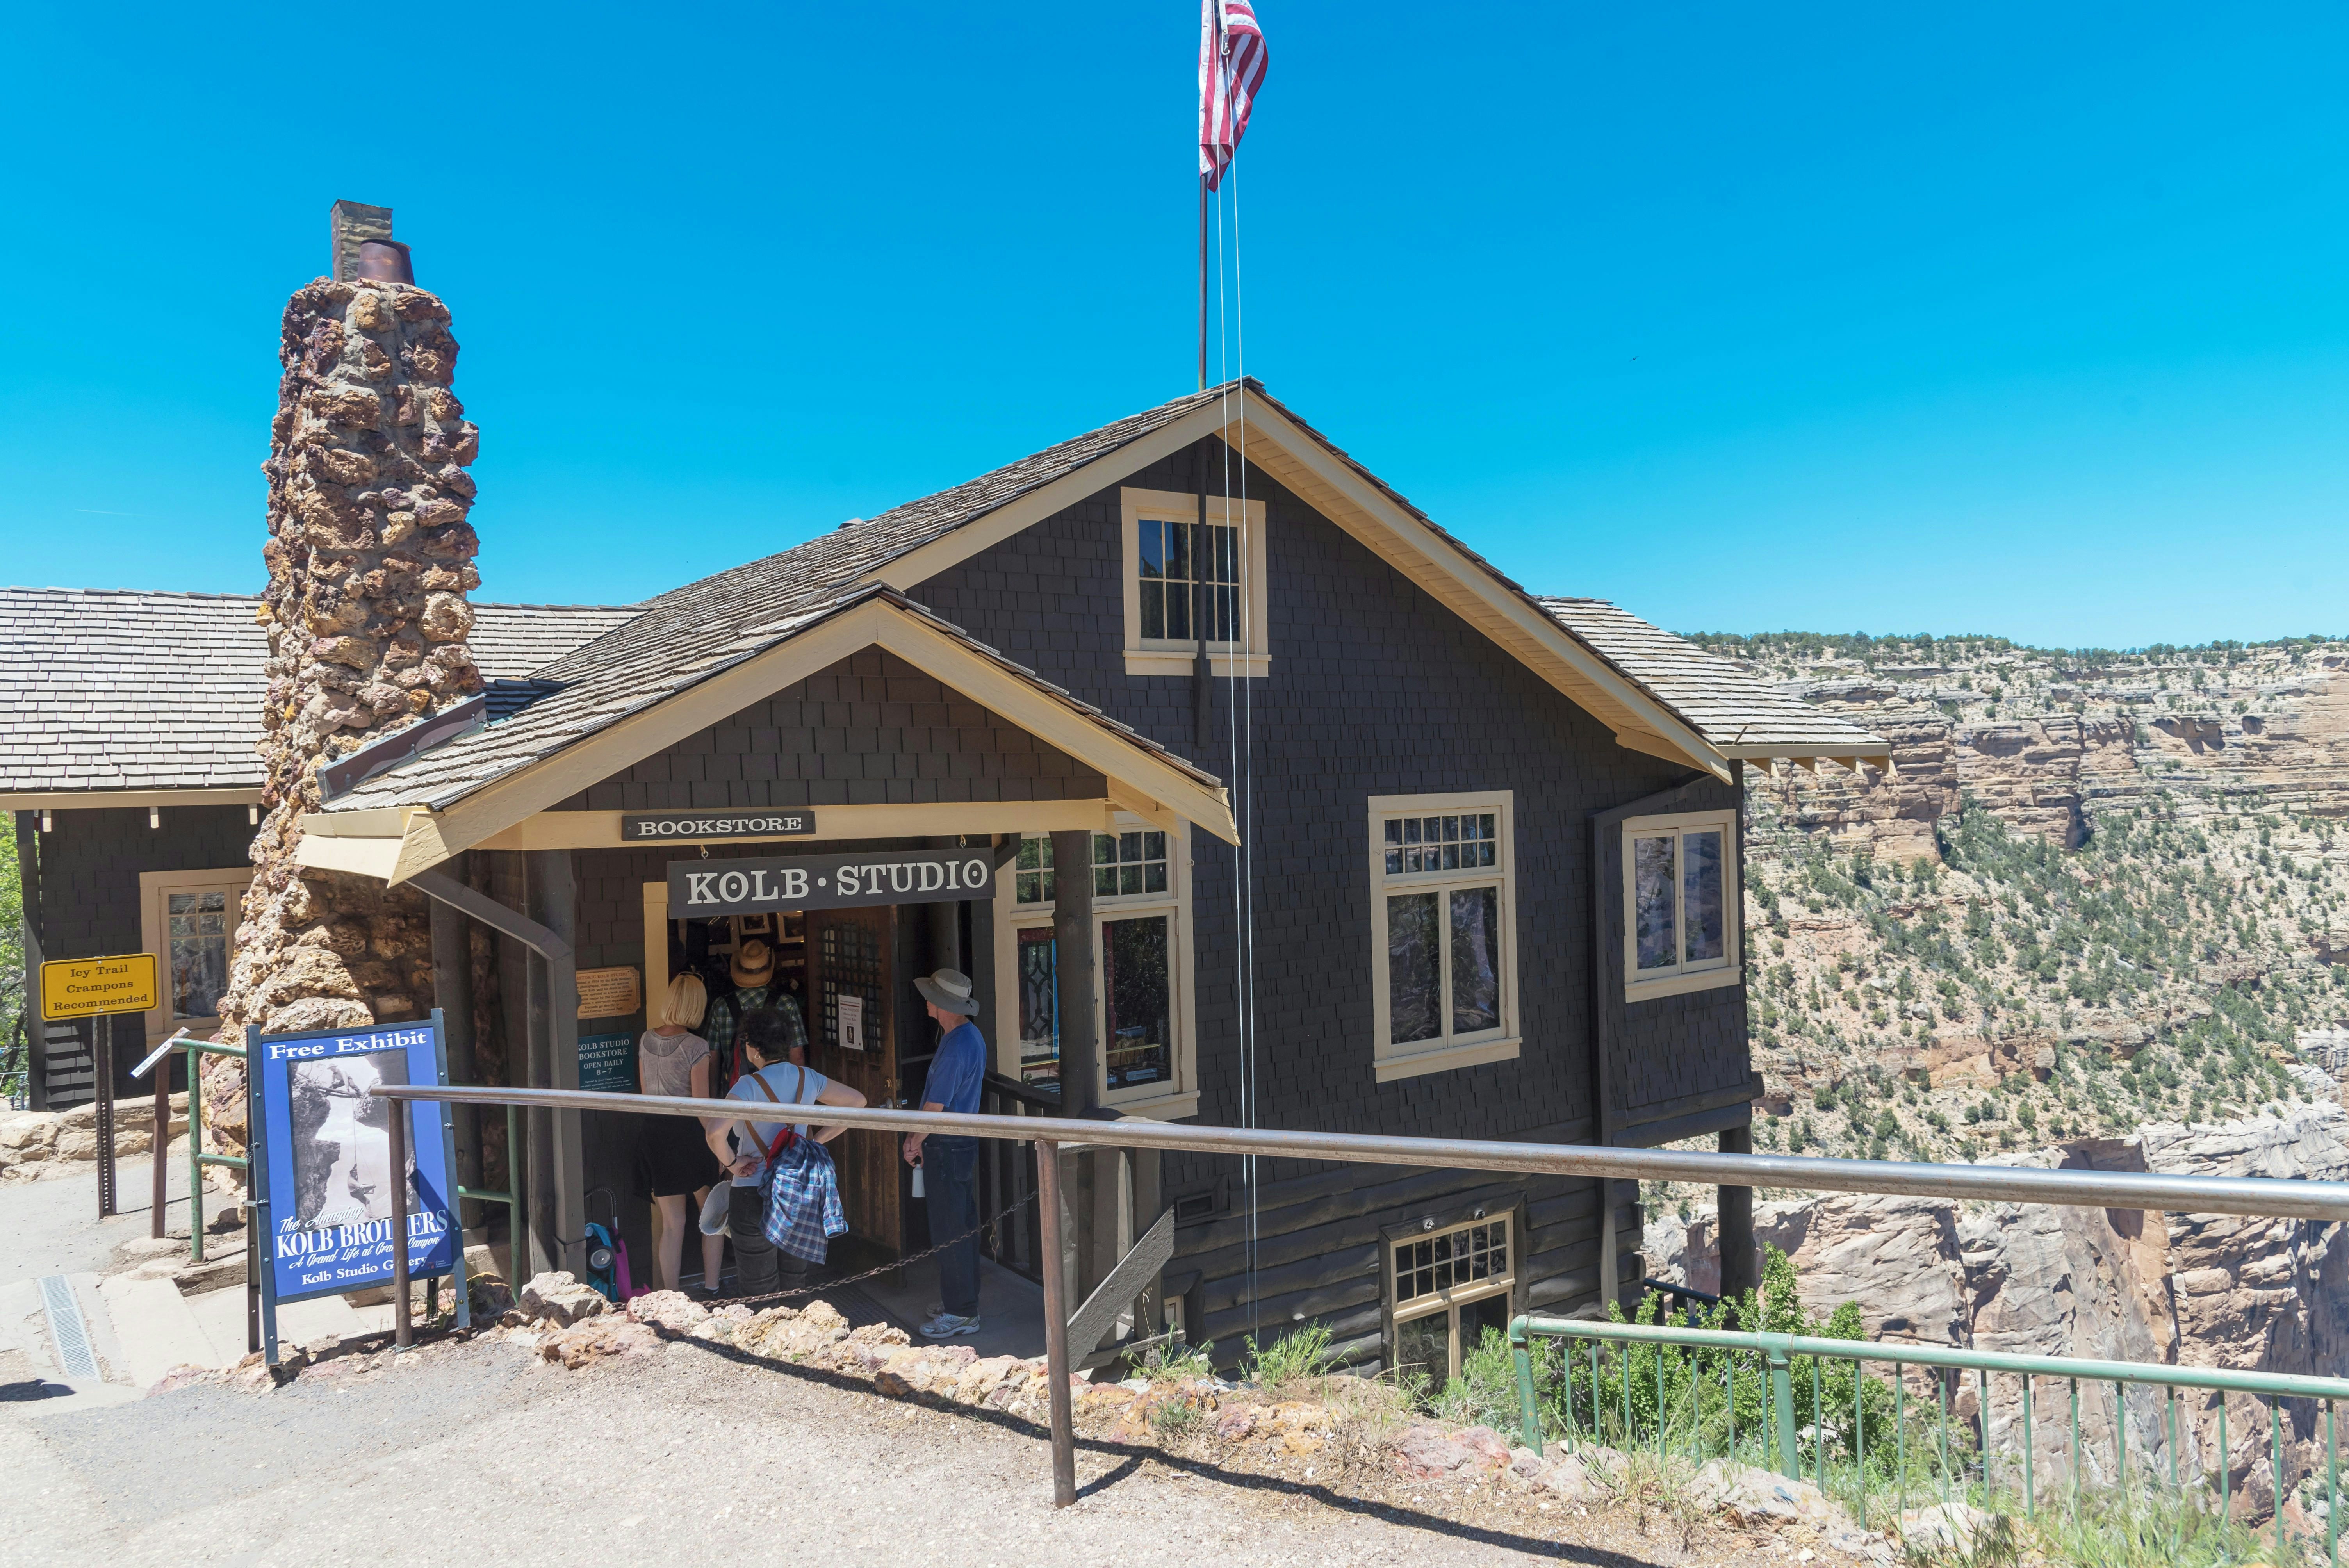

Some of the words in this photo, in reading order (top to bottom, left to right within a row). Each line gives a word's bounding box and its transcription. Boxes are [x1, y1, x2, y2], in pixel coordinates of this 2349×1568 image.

[638, 817, 802, 836] BOOKSTORE
[686, 868, 809, 905] KOLB
[836, 859, 988, 896] STUDIO
[70, 969, 91, 978] Icy
[96, 964, 128, 975] Trail
[66, 981, 134, 993] Crampons
[53, 994, 148, 1010] Recommended
[269, 1044, 325, 1059] Free
[335, 1031, 427, 1053] Exhibit
[578, 1043, 597, 1051] KOLB
[599, 1039, 630, 1049] STUDIO
[579, 1048, 628, 1060] BOOKSTORE
[584, 1061, 602, 1069] OPEN
[604, 1058, 624, 1067] DAILY
[280, 1216, 301, 1233] The
[304, 1206, 364, 1228] Amazing
[276, 1228, 334, 1258] KOLB
[339, 1210, 448, 1248] BROTERS
[289, 1255, 305, 1269] A
[306, 1249, 339, 1267] Grand
[340, 1246, 360, 1263] Life
[361, 1244, 375, 1257] at
[375, 1242, 394, 1256] Gra
[408, 1237, 440, 1249] Canyon
[301, 1270, 332, 1285] Kolb
[337, 1263, 378, 1279] Studio
[383, 1256, 428, 1270] Gery
